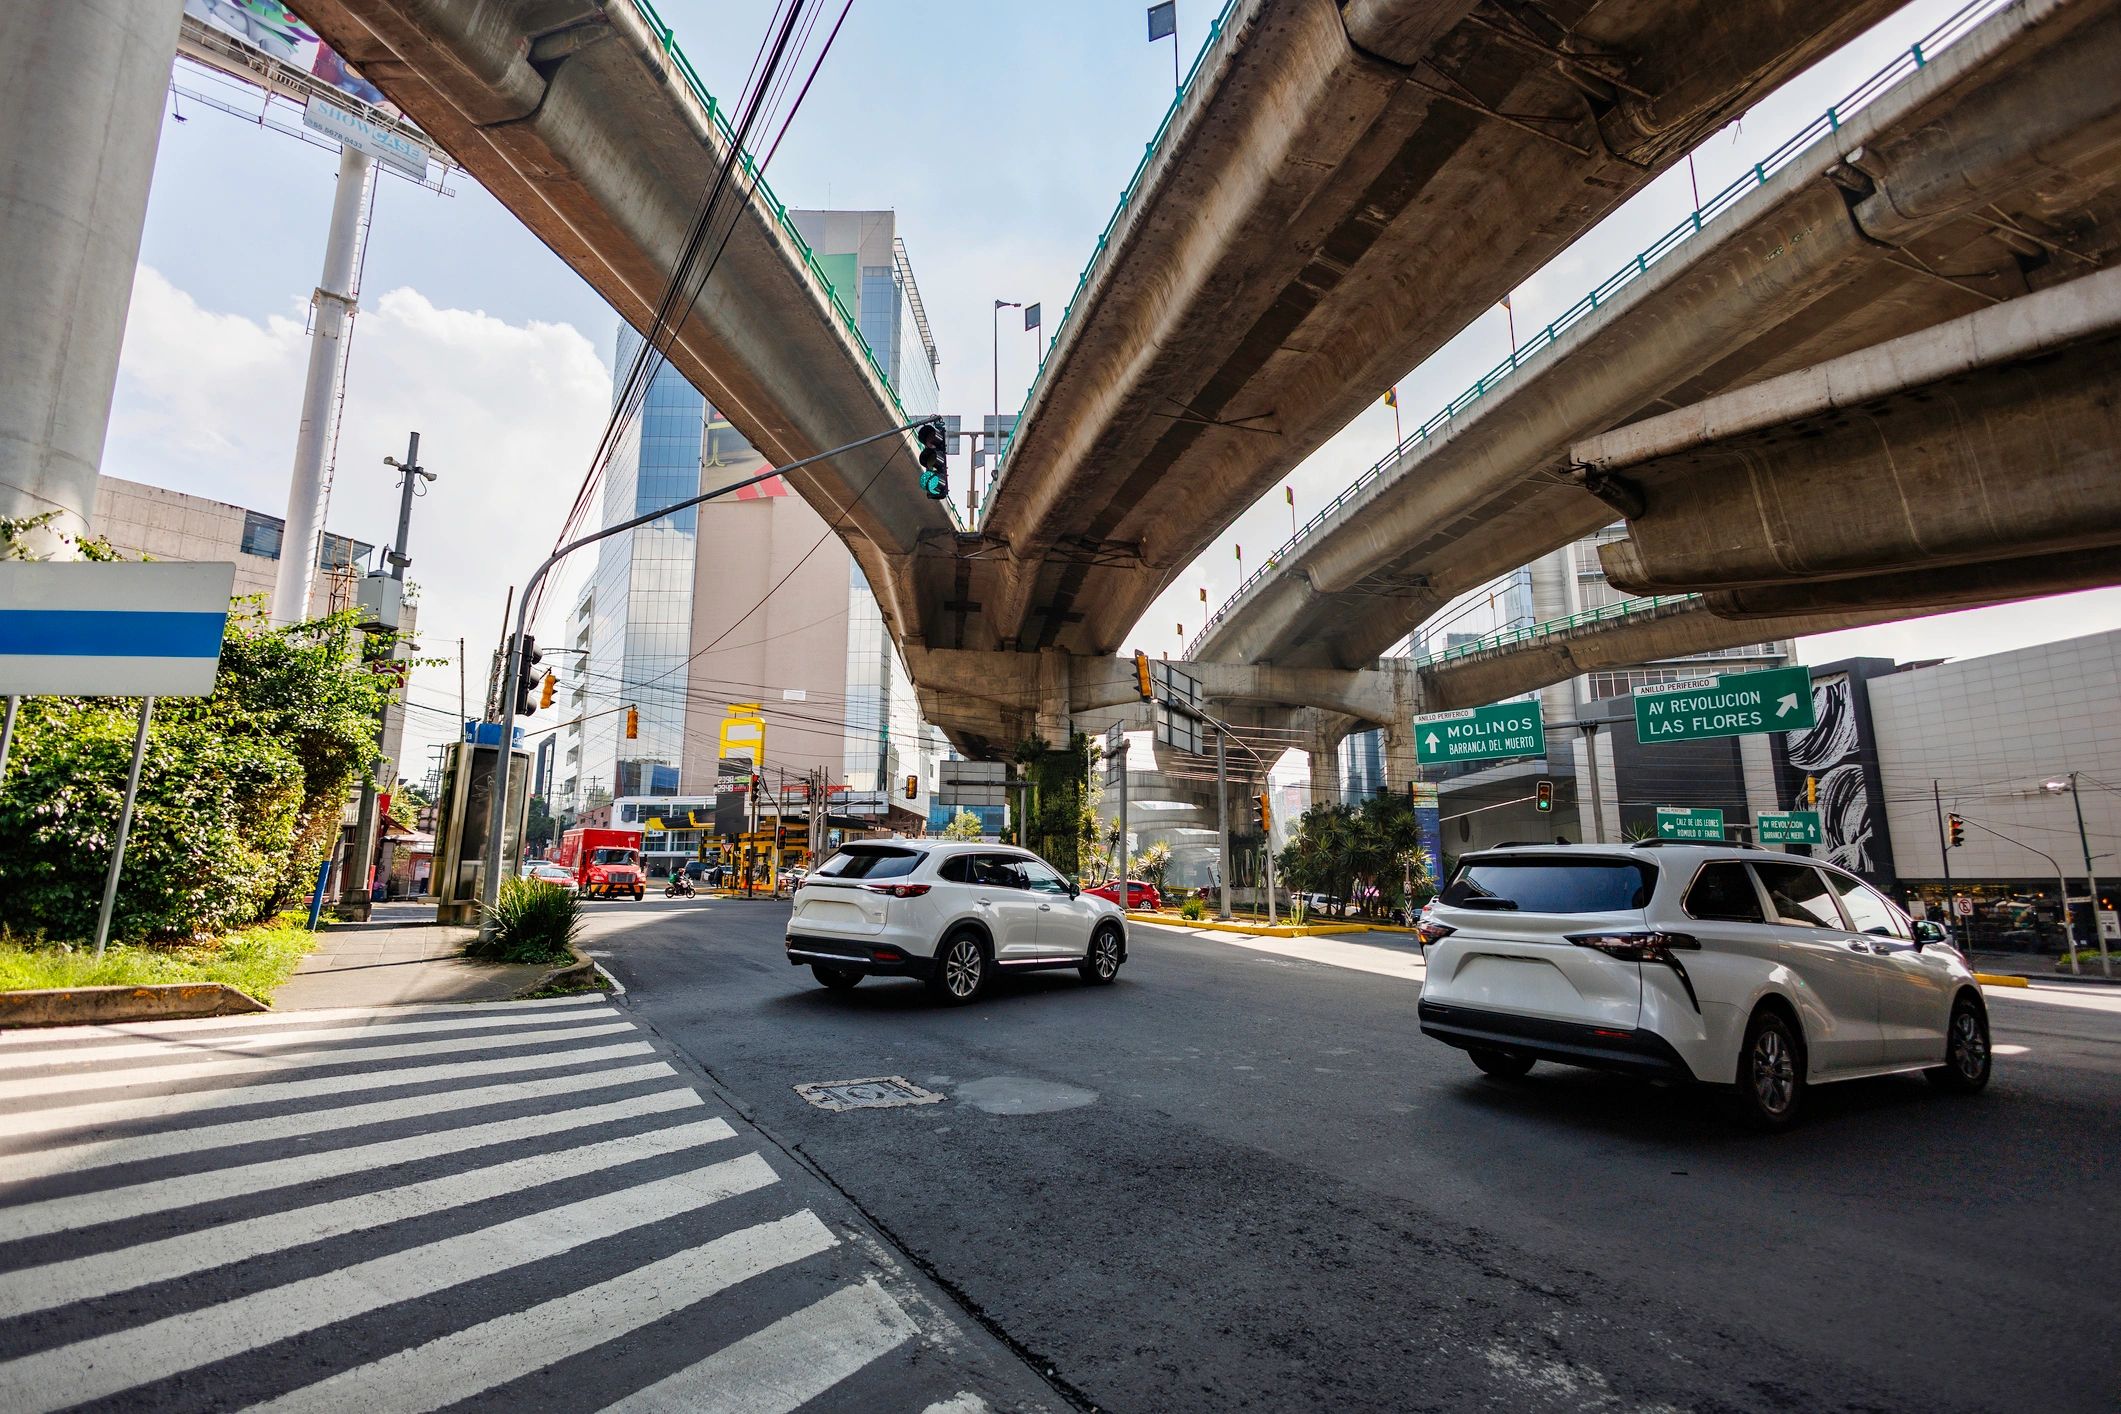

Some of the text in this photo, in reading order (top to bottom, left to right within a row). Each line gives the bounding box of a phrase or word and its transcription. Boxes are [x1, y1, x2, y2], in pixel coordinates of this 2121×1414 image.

[1640, 679, 1710, 694] ANILLO PERIFERICO
[1649, 691, 1761, 715] AV REVOLUCION
[1418, 710, 1469, 722] ANILLO PERIFERICO
[1650, 712, 1762, 735] LAS FLORES
[1447, 718, 1533, 738] MOLINOS
[1449, 736, 1534, 755] BARRANCA DEL MUERTO
[1695, 819, 1703, 827] LOS
